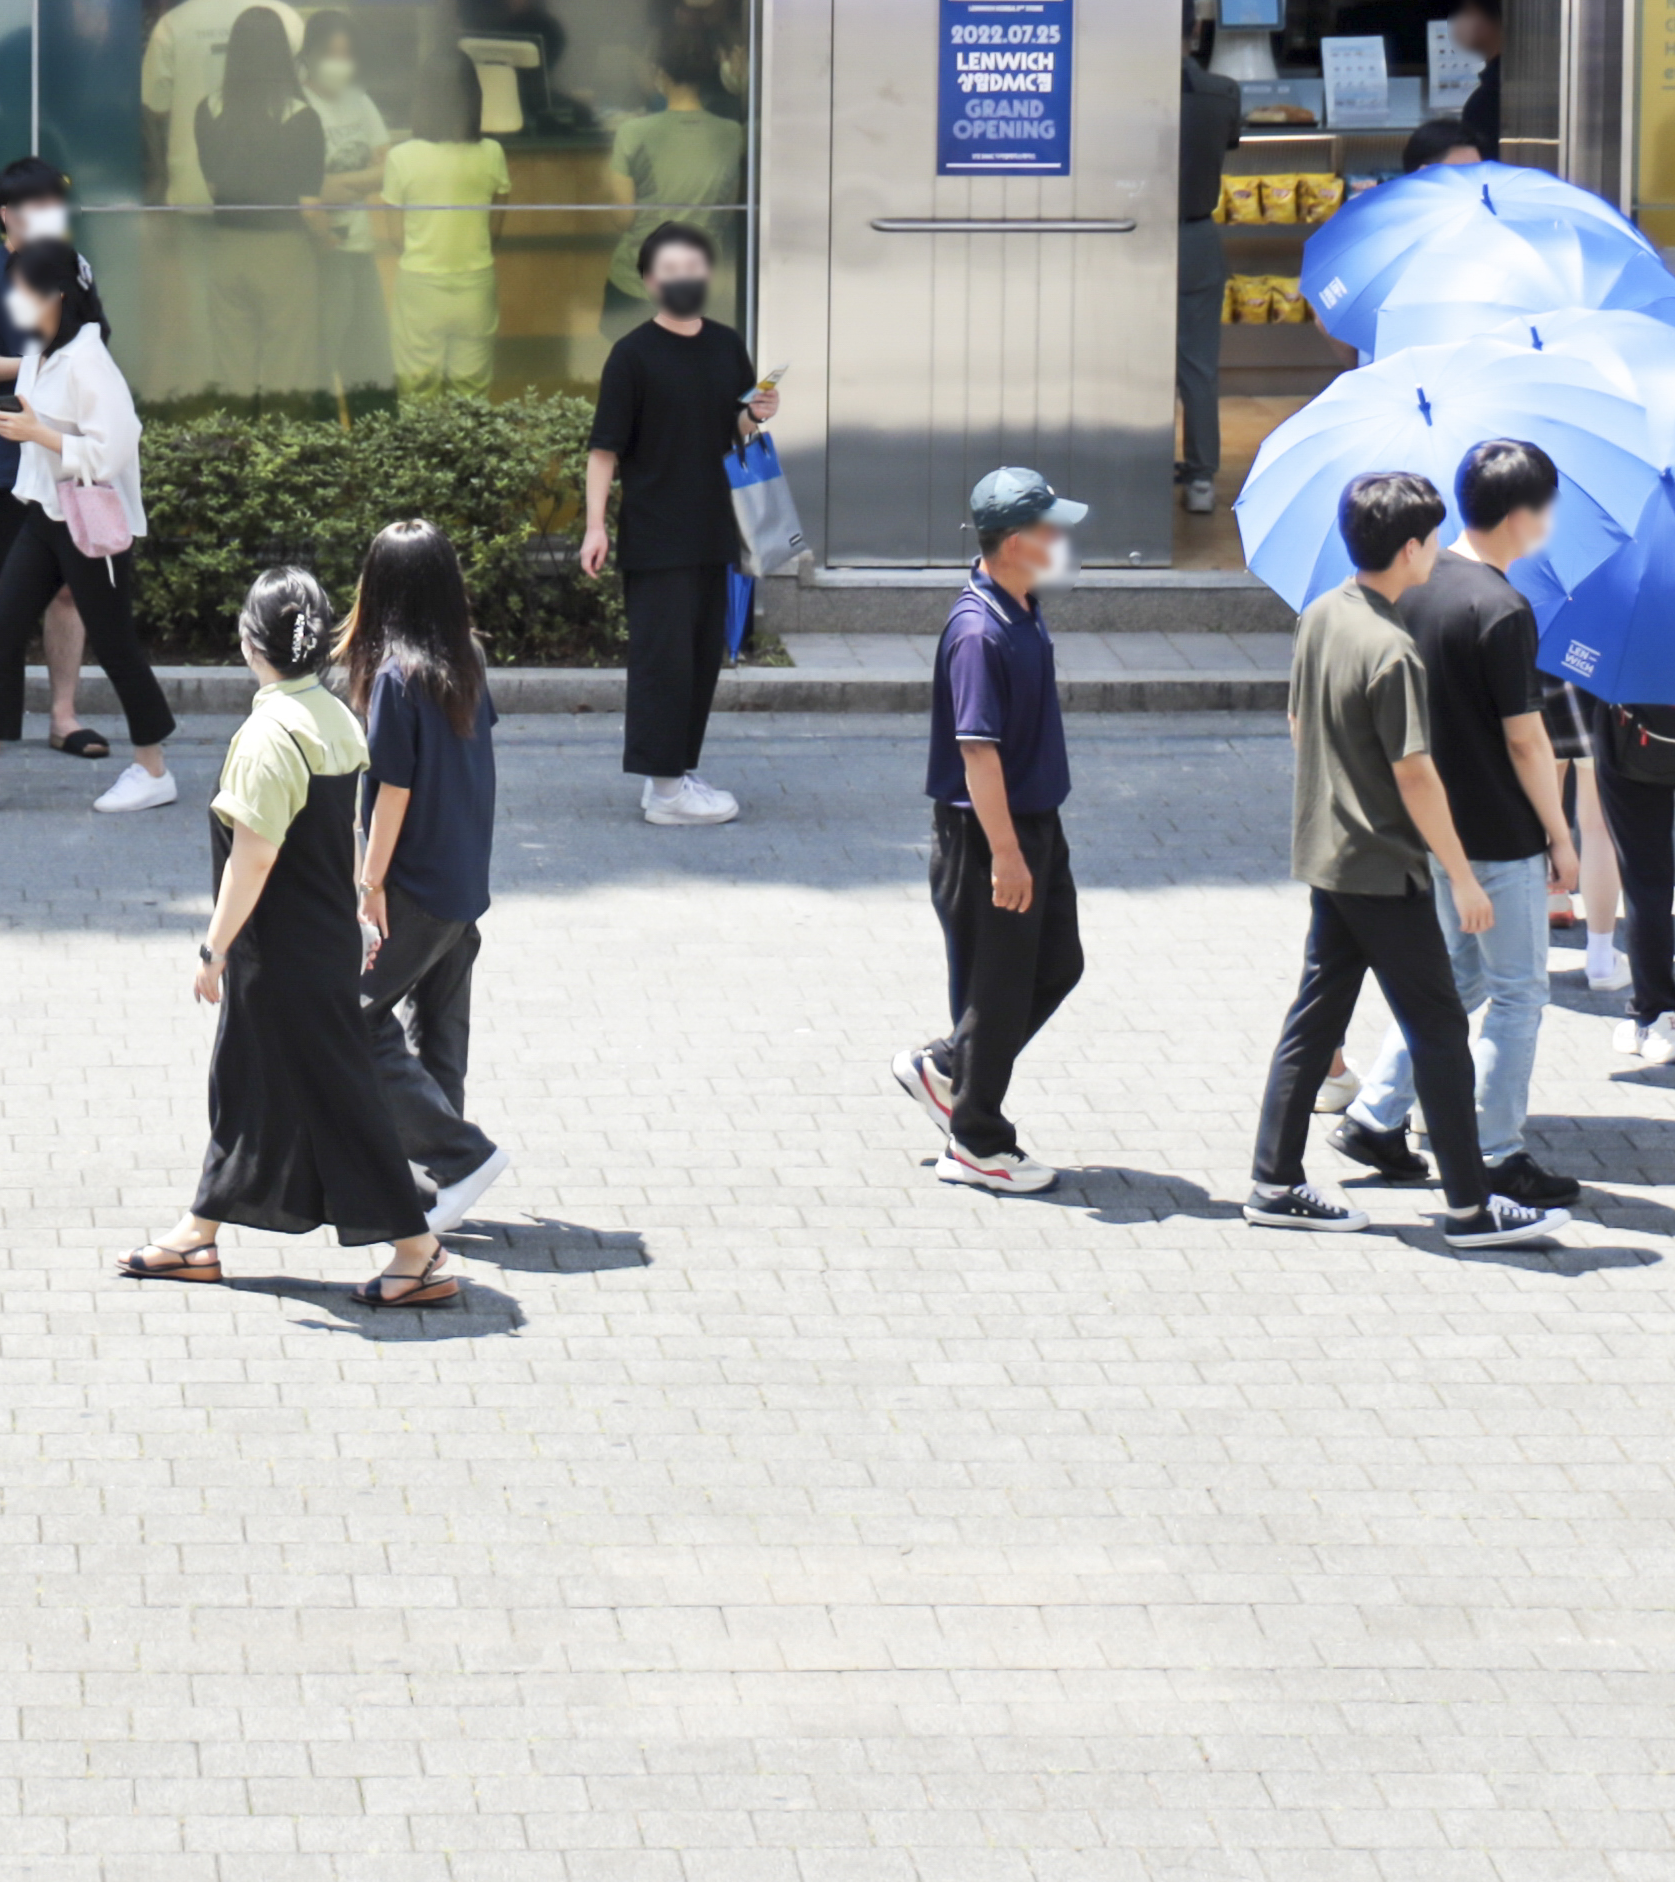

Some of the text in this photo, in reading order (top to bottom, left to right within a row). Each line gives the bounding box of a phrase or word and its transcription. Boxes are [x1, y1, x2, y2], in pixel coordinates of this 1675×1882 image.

[951, 24, 1061, 44] 2022.07.25
[957, 52, 1054, 71] LENWICH
[965, 98, 1044, 118] GRAND
[953, 120, 1056, 140] OPENING
[1568, 644, 1590, 659] LEN
